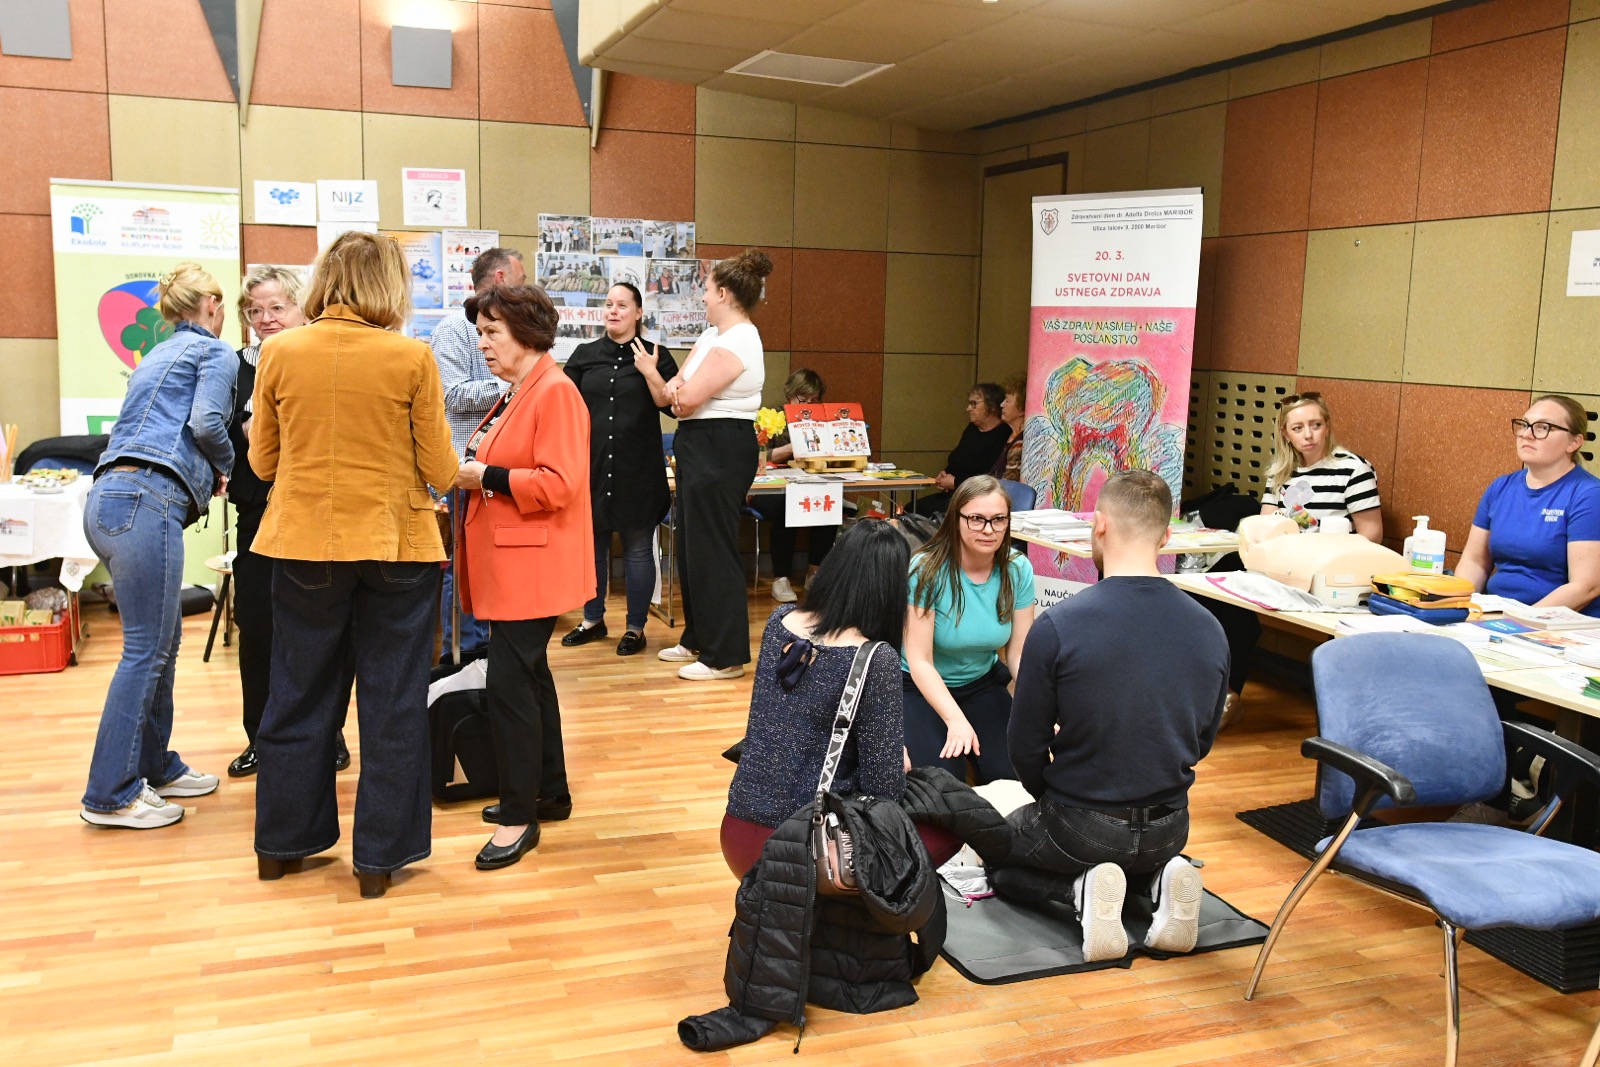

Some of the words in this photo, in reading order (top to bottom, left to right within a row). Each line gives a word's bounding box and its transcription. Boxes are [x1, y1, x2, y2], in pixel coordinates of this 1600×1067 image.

[332, 190, 363, 206] NIJZ
[1163, 208, 1194, 216] MARIBOR
[71, 237, 107, 247] Ekošola
[1095, 251, 1112, 261] 20.
[1115, 250, 1125, 261] 3.
[125, 272, 156, 280] OSNOVNA
[1067, 272, 1123, 283] SVETOVNI
[1126, 272, 1151, 282] DAN
[1055, 287, 1107, 297] USTNEGA
[1110, 287, 1162, 297] ZDRAVJA
[1043, 318, 1061, 331] VAŠ
[1062, 321, 1094, 331] ZDRAV
[1095, 321, 1137, 332] NASMEH
[1145, 320, 1173, 332] NAŠE
[1073, 333, 1138, 345] POSLANSTVO
